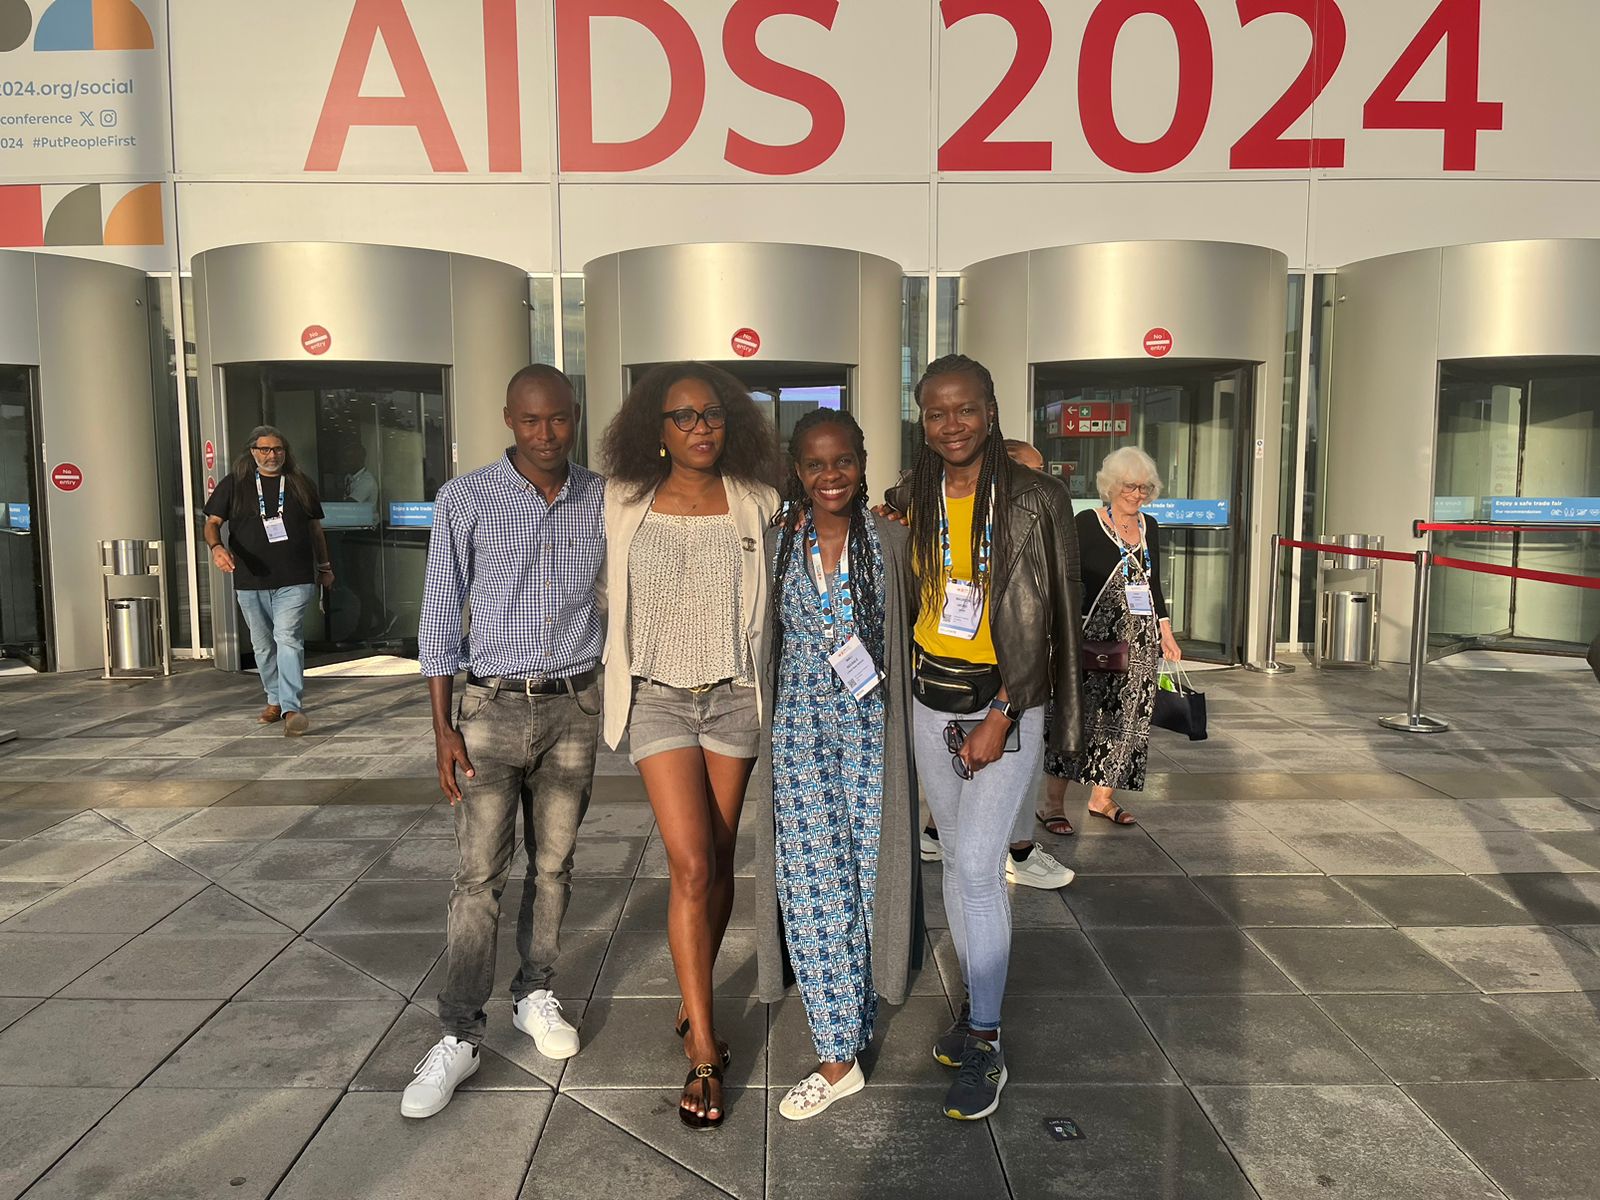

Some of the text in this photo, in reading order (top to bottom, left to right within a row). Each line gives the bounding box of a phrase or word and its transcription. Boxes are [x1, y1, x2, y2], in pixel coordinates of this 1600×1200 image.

[0, 78, 134, 99] 024.org/social
[303, 0, 1504, 175] AIDS 2024
[32, 134, 137, 149] #PutPeopleFirst
[736, 343, 752, 353] entry
